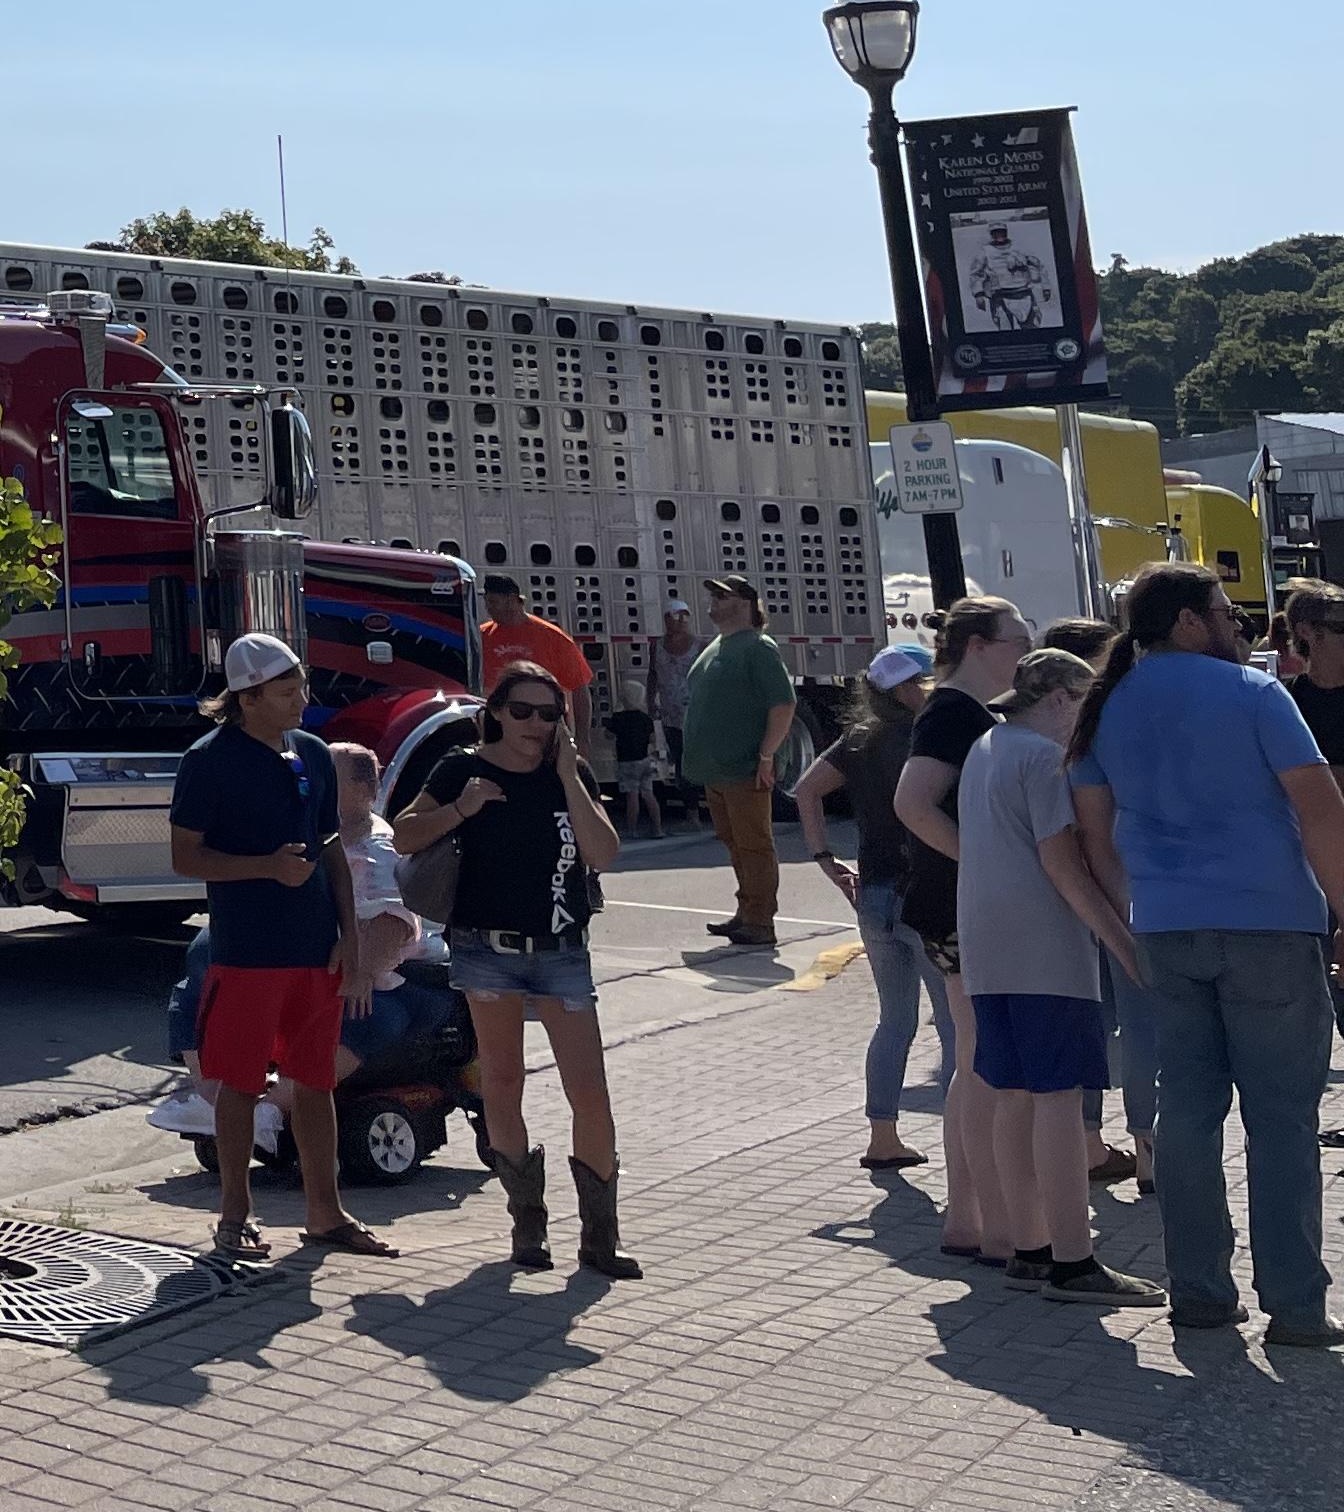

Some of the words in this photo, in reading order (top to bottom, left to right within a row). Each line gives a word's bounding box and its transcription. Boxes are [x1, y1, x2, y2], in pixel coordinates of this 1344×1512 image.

[939, 156, 983, 169] KAREN
[1004, 151, 1044, 164] MOSES
[945, 168, 998, 179] NATIONAL
[1000, 163, 1040, 175] GUARD
[943, 187, 980, 198] UNITED
[982, 184, 1014, 195] STATES
[1017, 182, 1048, 192] ARMY
[904, 460, 911, 473] 2
[916, 458, 947, 470] HOUR
[905, 473, 951, 487] PARKING
